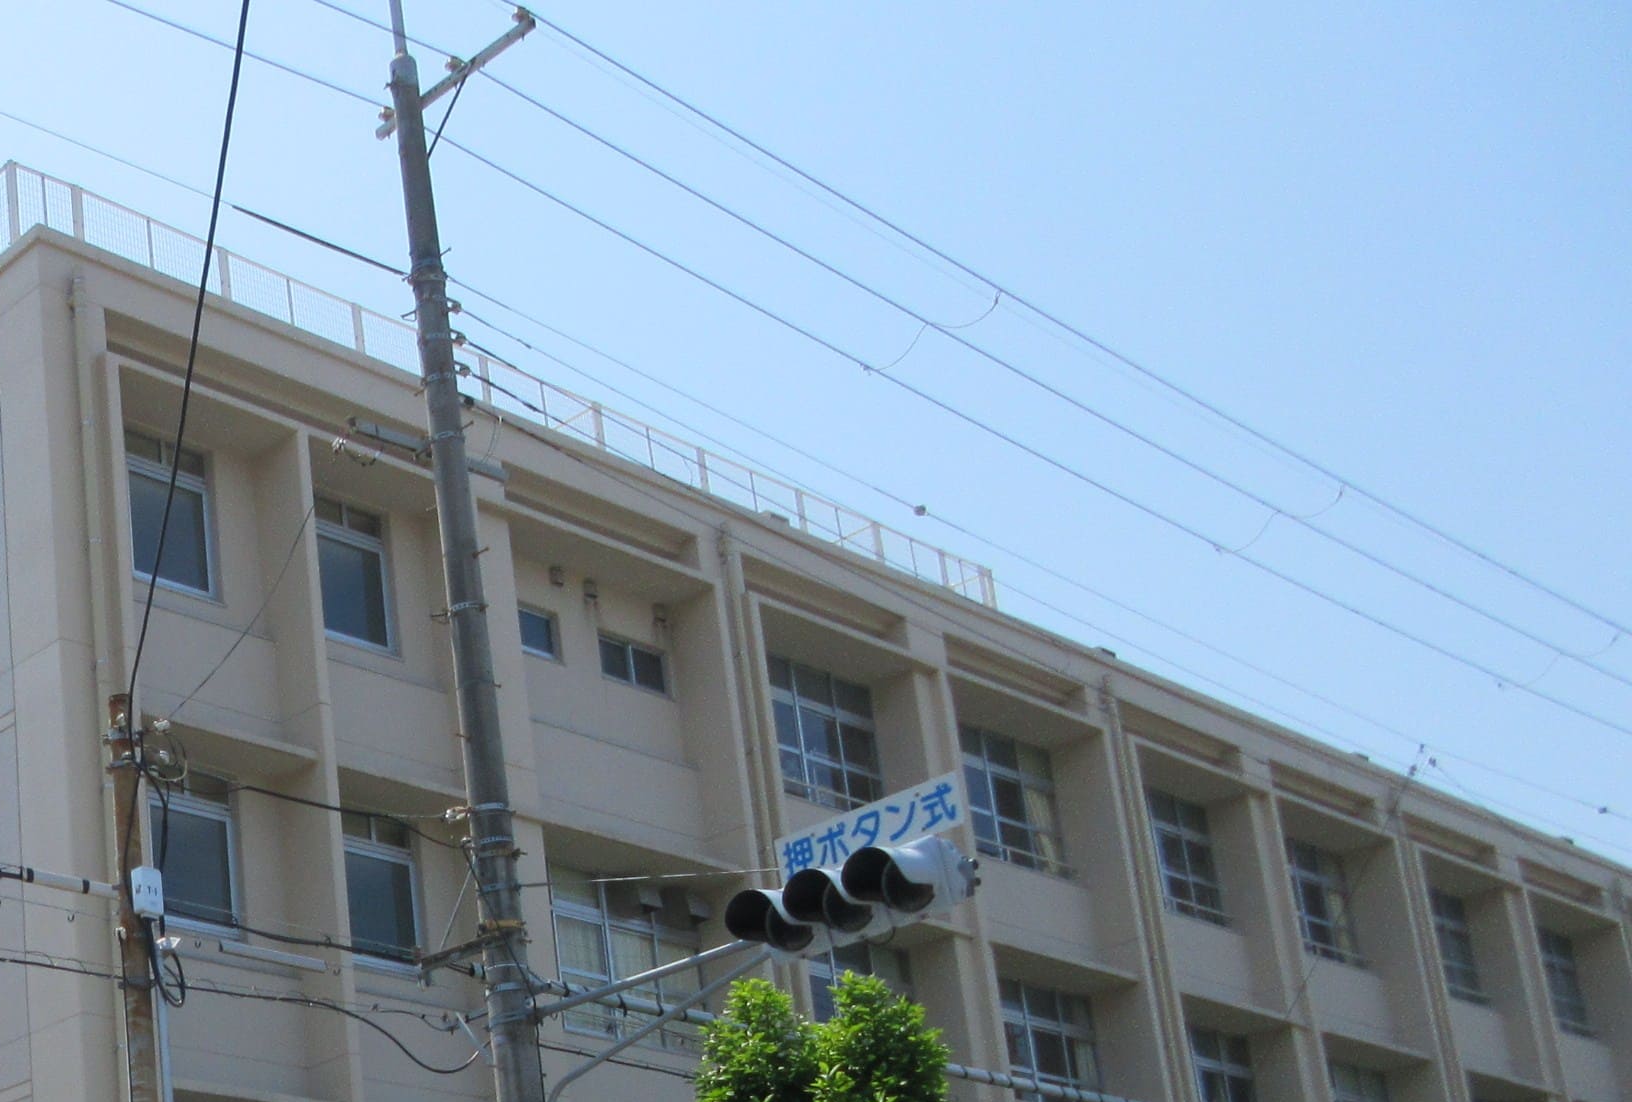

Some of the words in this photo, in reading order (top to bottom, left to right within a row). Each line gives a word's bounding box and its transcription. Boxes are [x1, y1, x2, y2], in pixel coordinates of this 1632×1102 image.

[783, 782, 957, 880] 押ボタン式
